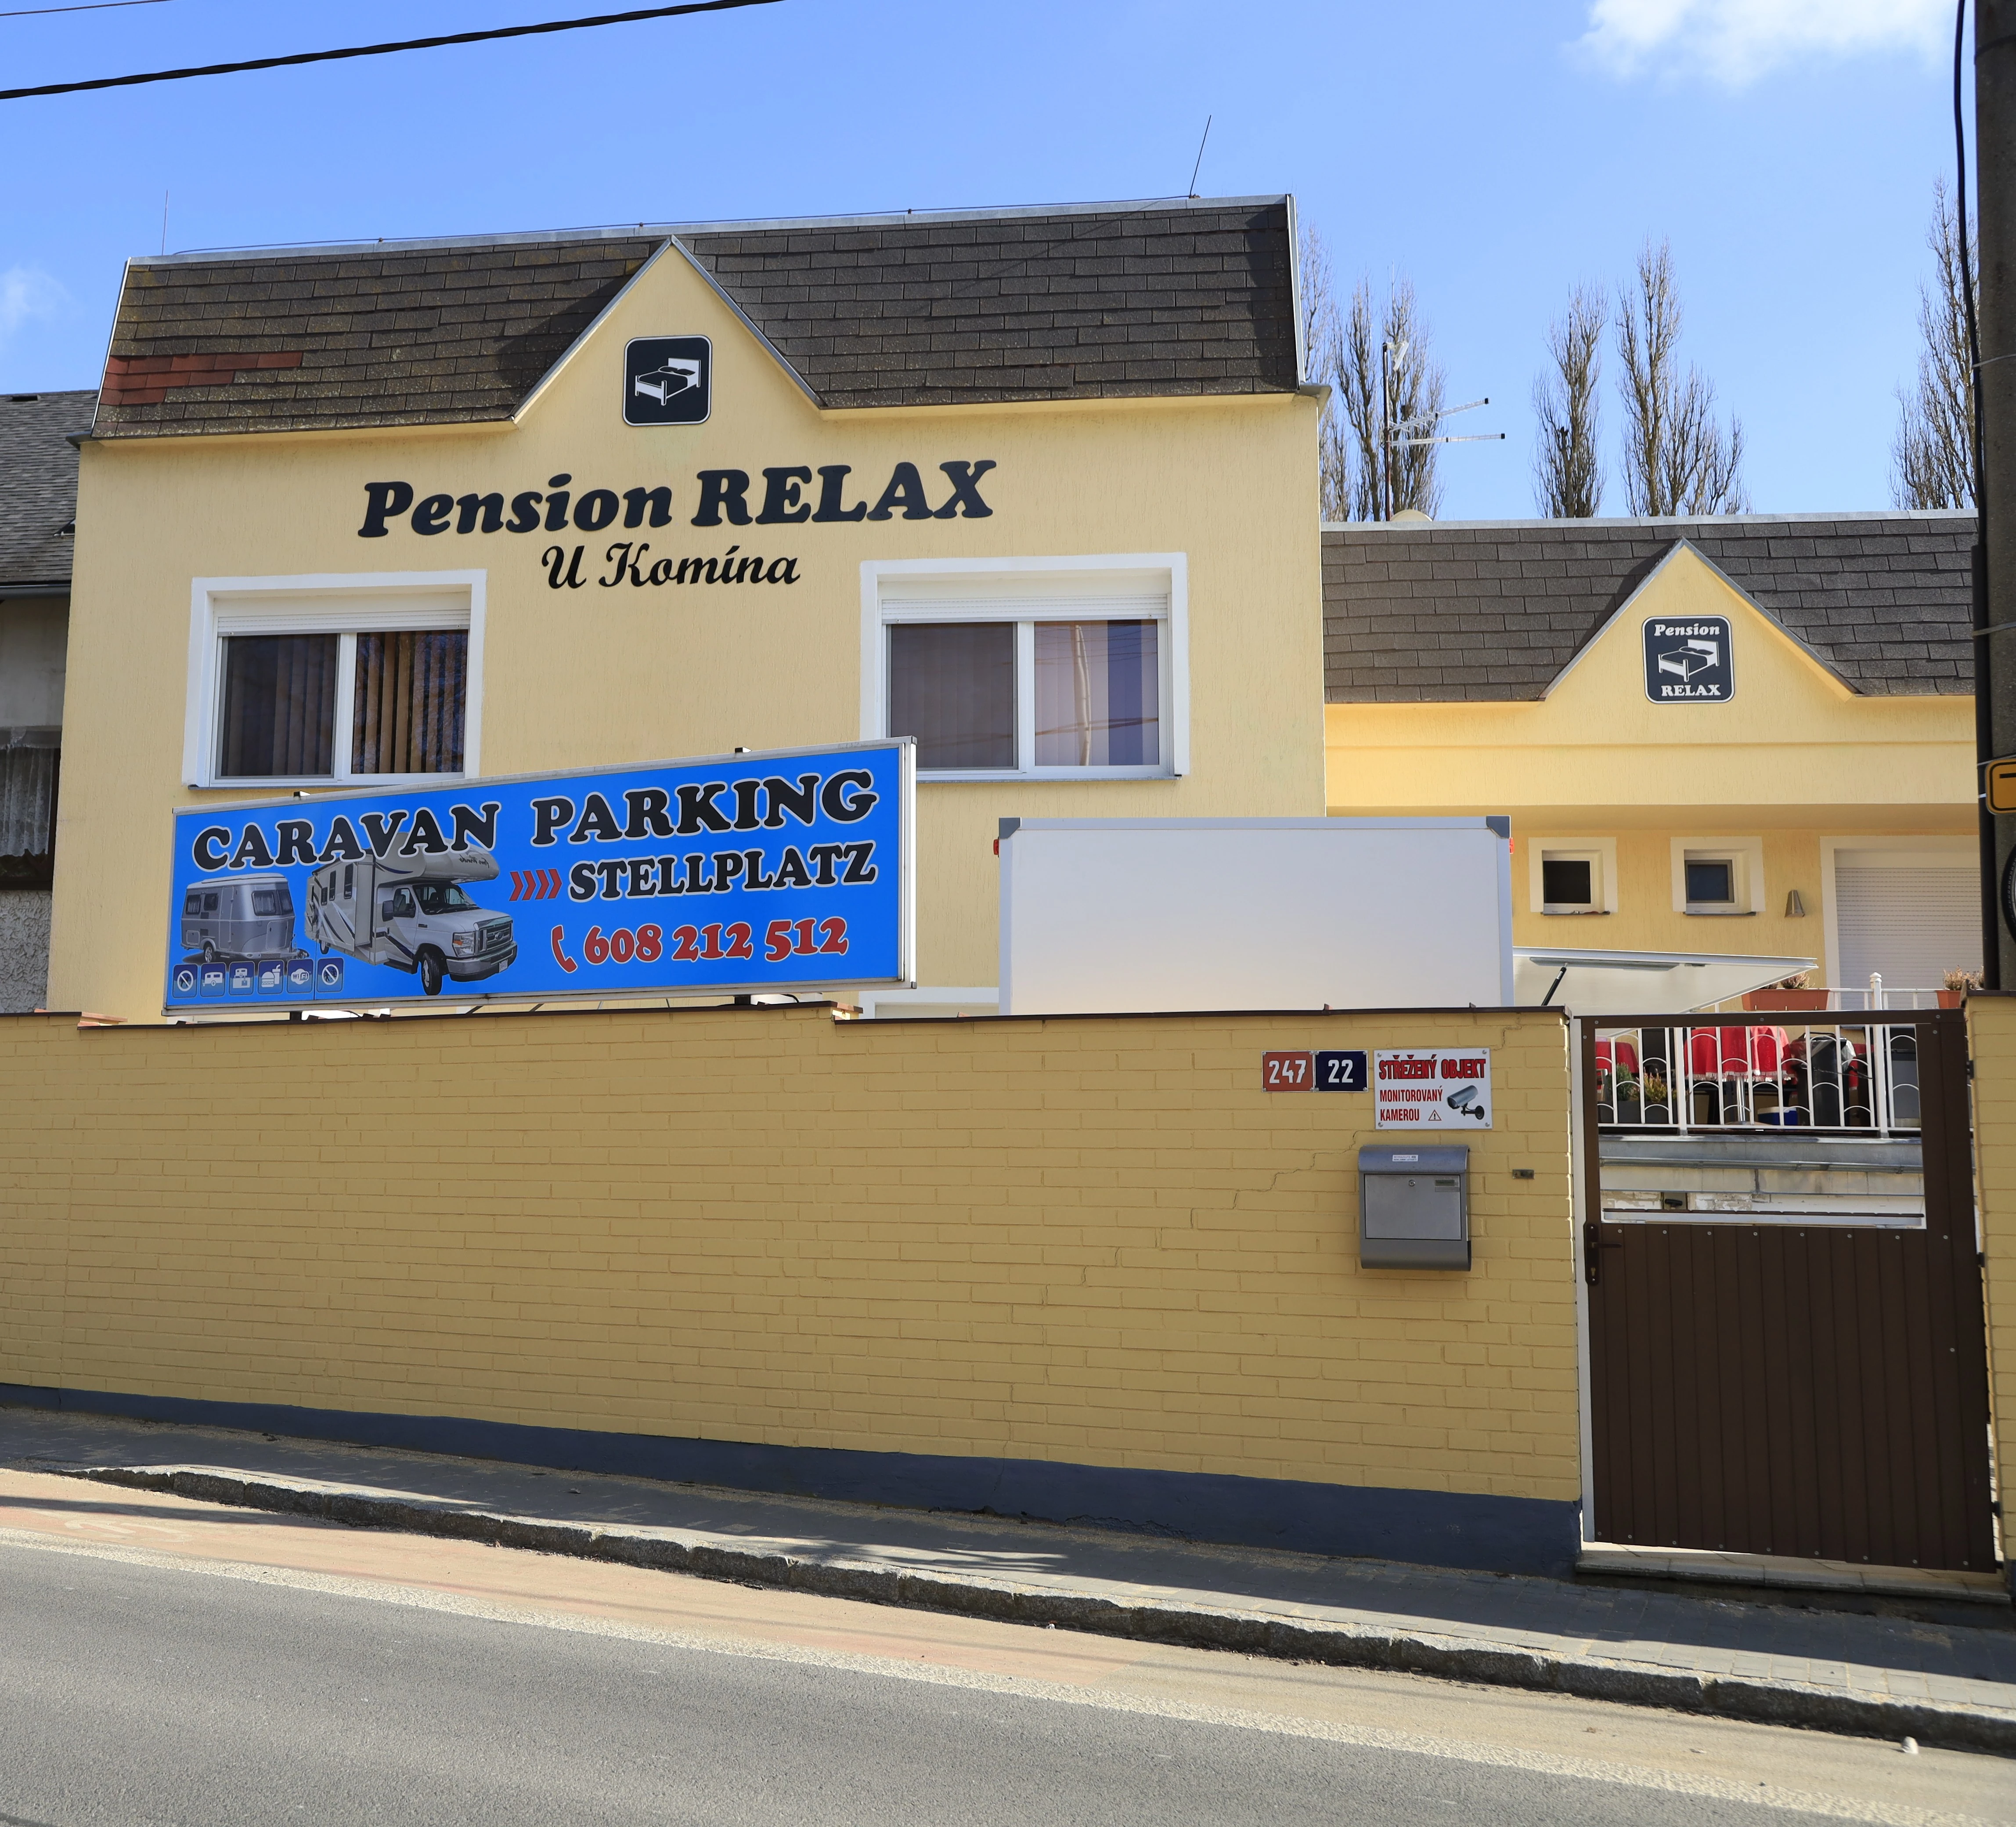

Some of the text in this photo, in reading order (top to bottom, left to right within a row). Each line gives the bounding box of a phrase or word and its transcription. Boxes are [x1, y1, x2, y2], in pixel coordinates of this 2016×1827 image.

[357, 460, 997, 538] Pension RELAX
[541, 542, 801, 589] U Komína
[1654, 623, 1720, 636] Pension
[1661, 684, 1721, 697] RELAX
[192, 769, 879, 871] CARAVAN PARKING
[569, 841, 877, 901] STELLPLATZ
[584, 917, 848, 964] 608 212 512
[1269, 1060, 1306, 1083] 247
[1328, 1059, 1353, 1083] 22
[1379, 1054, 1486, 1080] STŘEŽENÝ OBJEKT
[1380, 1086, 1443, 1102] MONITOROVANÝ
[1380, 1108, 1420, 1121] KAMEROU
